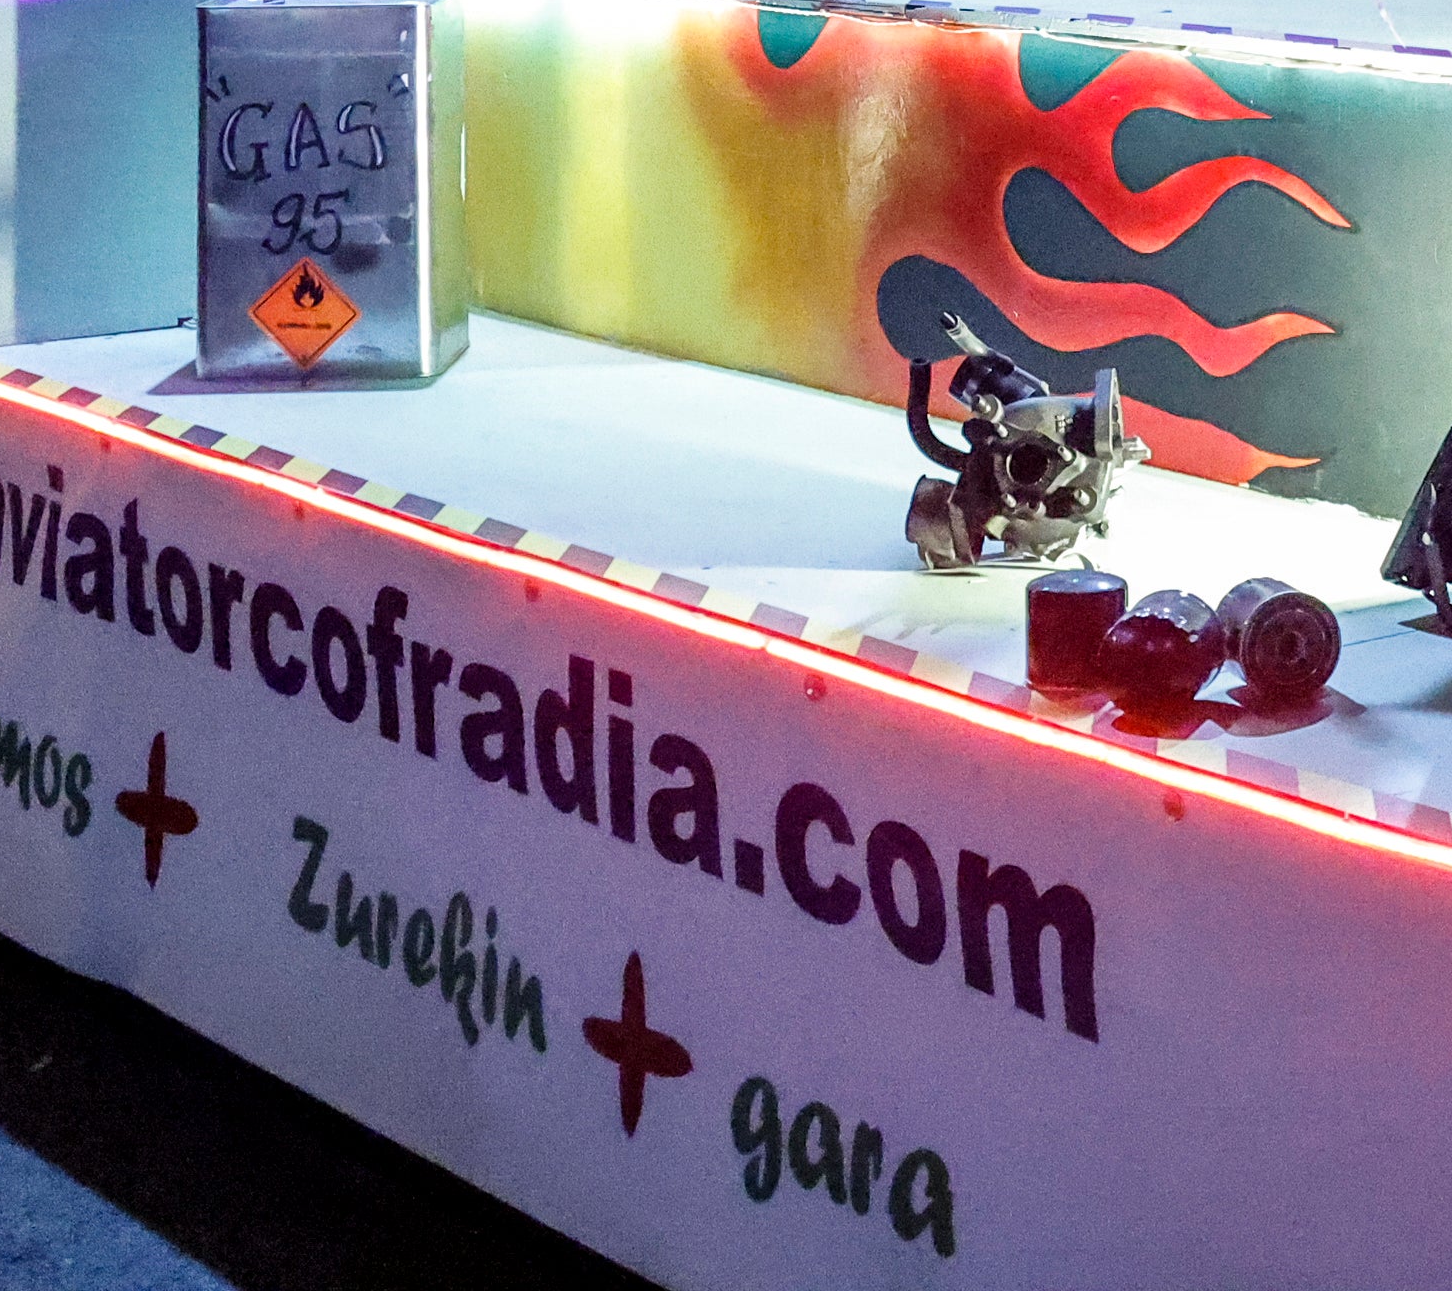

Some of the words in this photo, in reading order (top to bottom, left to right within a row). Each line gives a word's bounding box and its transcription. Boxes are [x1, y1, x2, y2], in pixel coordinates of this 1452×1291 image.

[260, 189, 351, 258] 95
[287, 816, 549, 1055] Zurekin
[732, 1076, 956, 1257] gara
